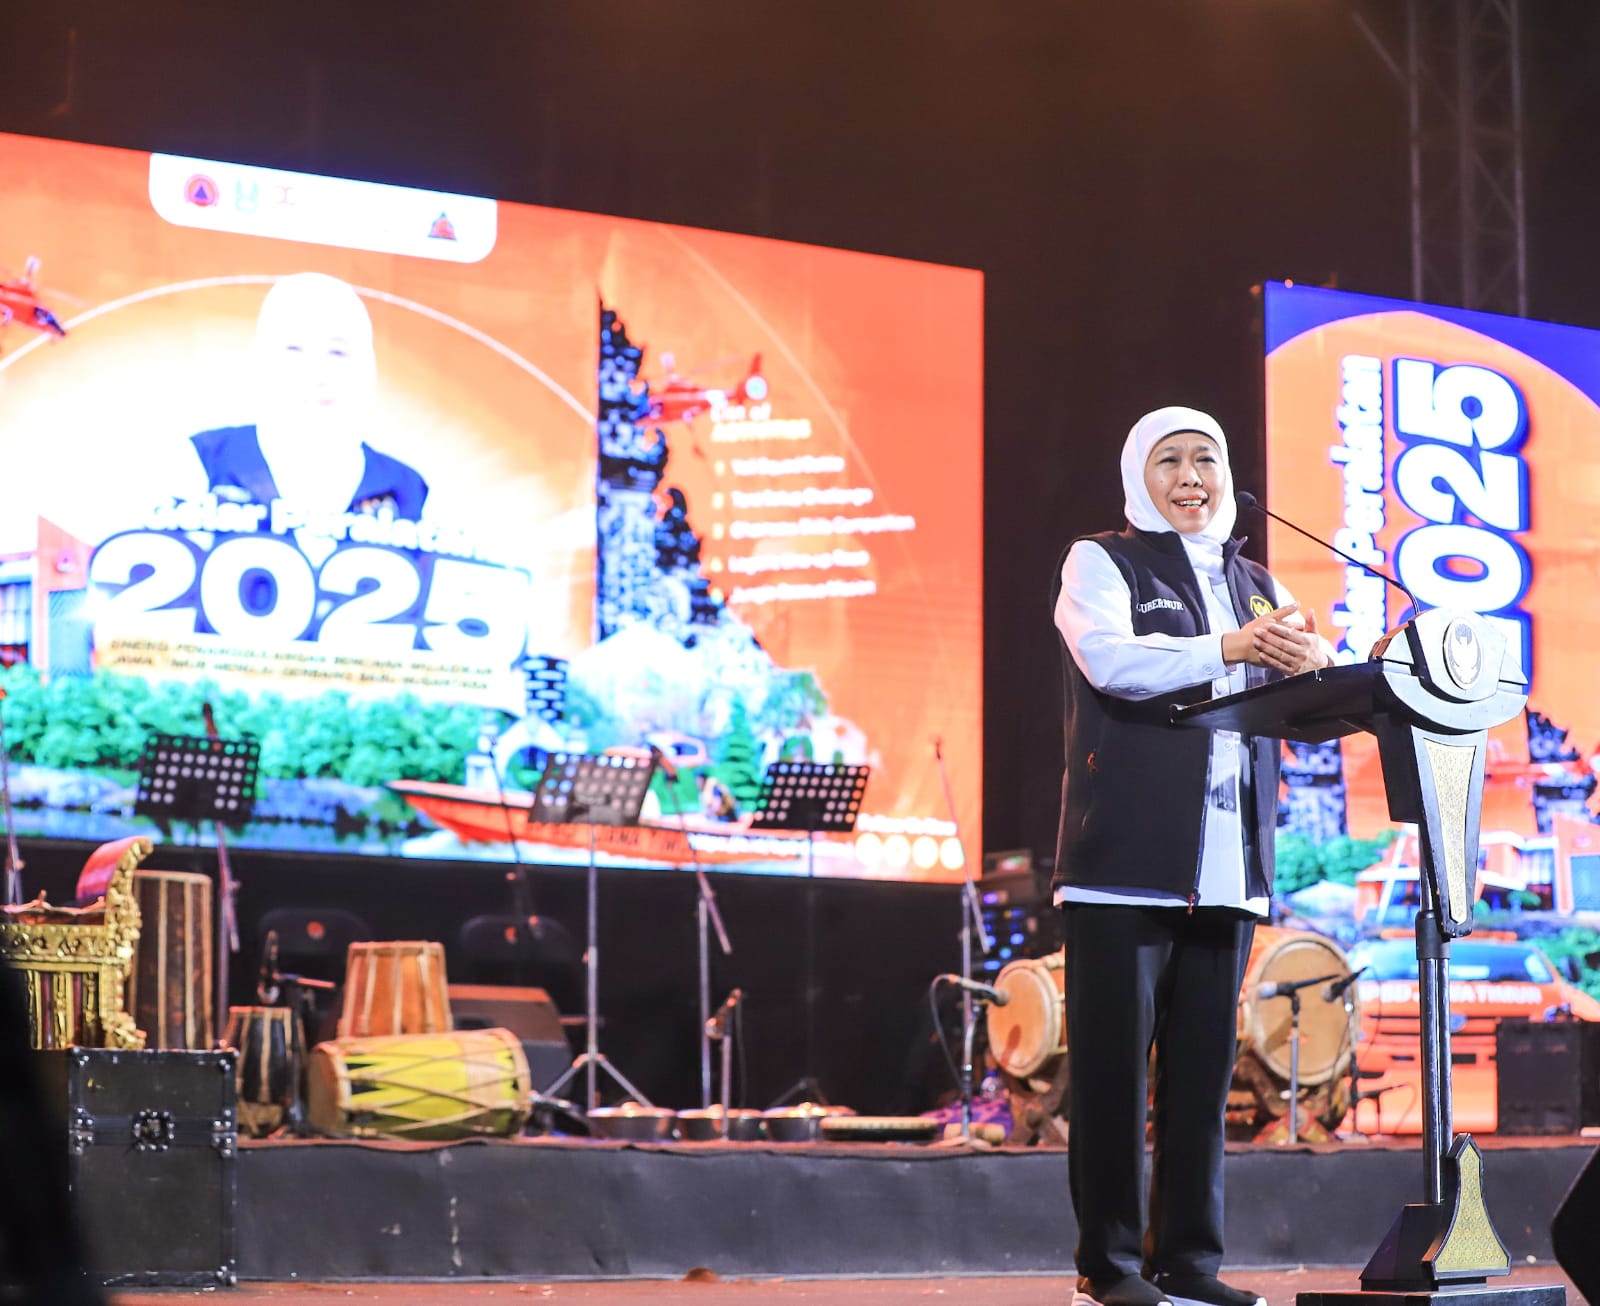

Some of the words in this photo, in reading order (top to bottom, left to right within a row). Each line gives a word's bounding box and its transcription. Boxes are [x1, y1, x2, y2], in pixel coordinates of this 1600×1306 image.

[1329, 355, 1385, 566] Peralatan
[1395, 358, 1530, 684] 025
[91, 530, 529, 662] 2025
